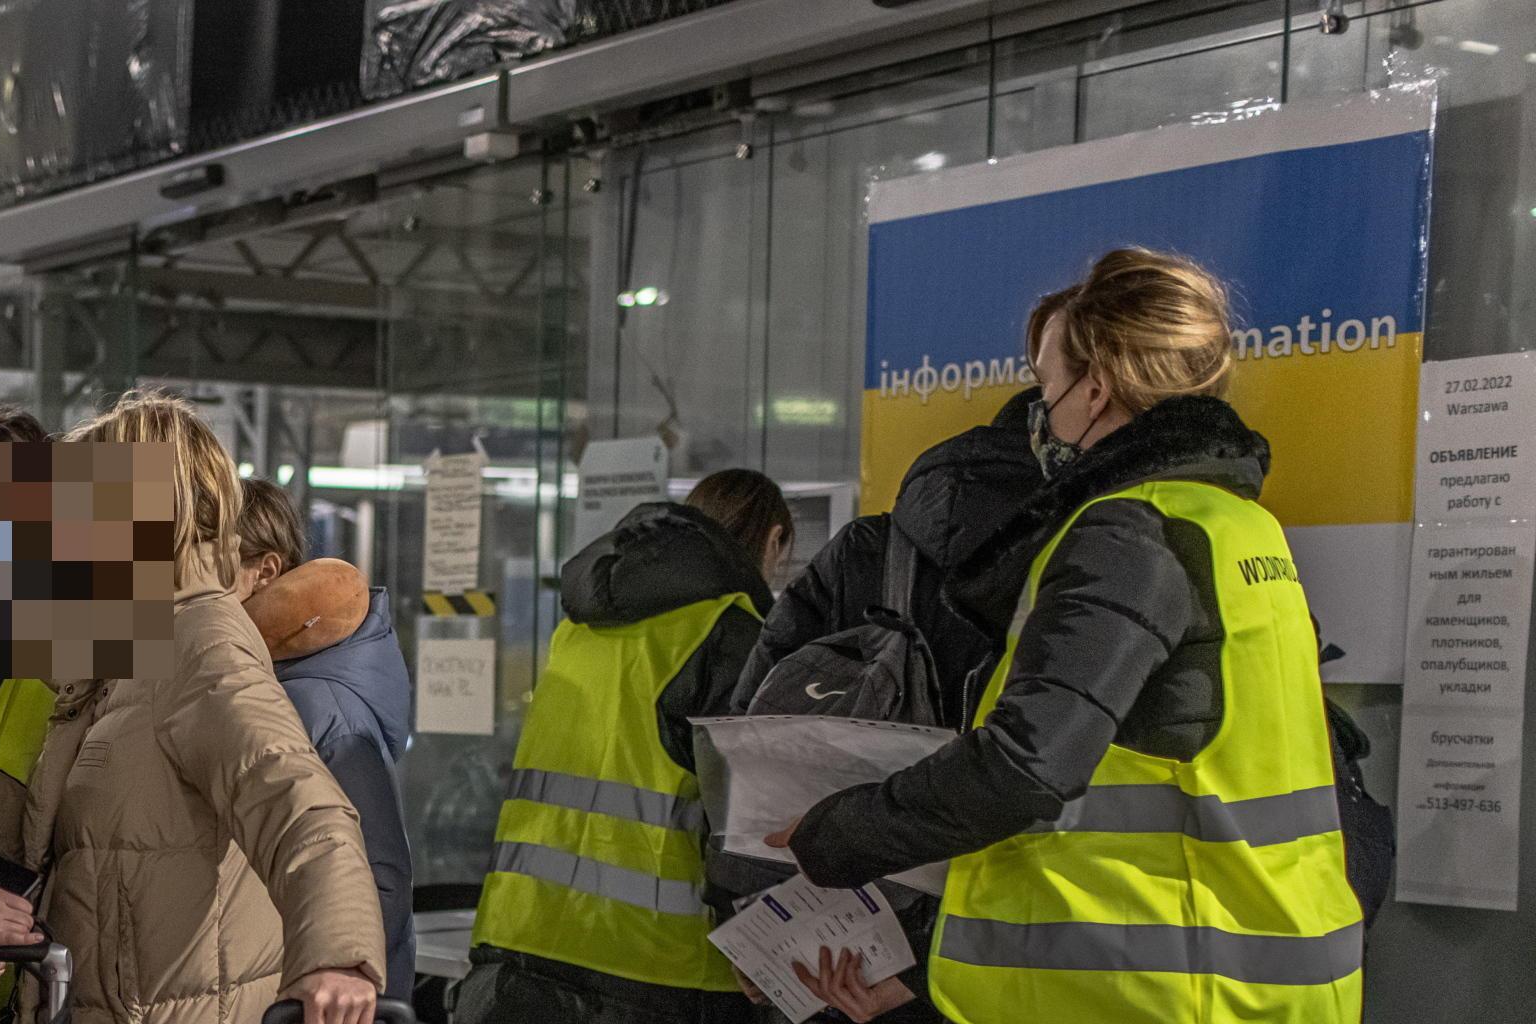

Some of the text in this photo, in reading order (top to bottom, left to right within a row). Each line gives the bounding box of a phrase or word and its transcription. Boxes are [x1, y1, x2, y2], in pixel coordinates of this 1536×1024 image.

[1230, 308, 1397, 361] mation
[880, 355, 1037, 404] інформа
[1445, 375, 1513, 394] 27.02.2022
[1447, 401, 1509, 416] Warszawa
[1430, 445, 1518, 464] ОБЪЯВЛЕНИЕ
[1440, 472, 1511, 489] предлагаю
[1447, 495, 1493, 511] работу
[1428, 546, 1516, 559] гарантирован
[1429, 569, 1512, 580] ным жильем
[1457, 594, 1482, 606] для
[1426, 616, 1510, 628] каменщиков,
[1431, 636, 1502, 650] плотников,
[1439, 681, 1492, 693] укладки
[1431, 731, 1494, 746] брусчатки
